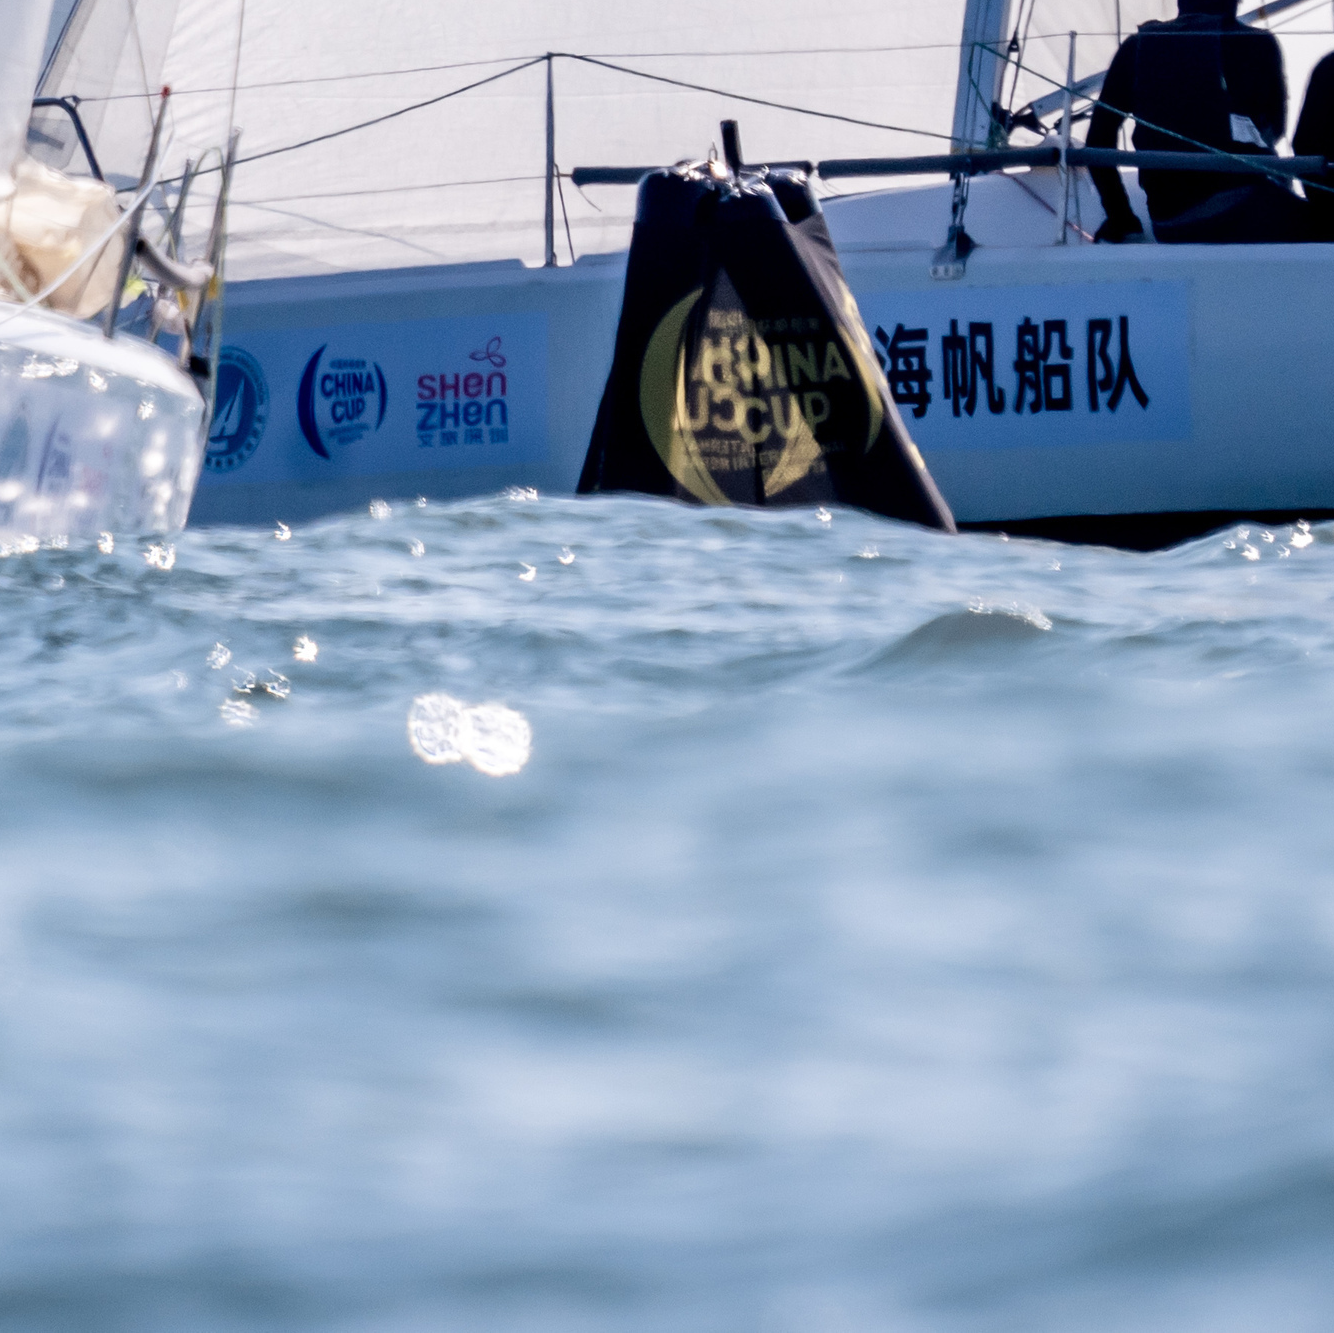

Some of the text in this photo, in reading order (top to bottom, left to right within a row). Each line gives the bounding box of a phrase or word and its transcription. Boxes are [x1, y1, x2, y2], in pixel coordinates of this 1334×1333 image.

[320, 371, 376, 399] CHINA
[873, 315, 1150, 420] 海帆船队
[331, 396, 366, 424] CUP
[738, 390, 831, 444] CUP
